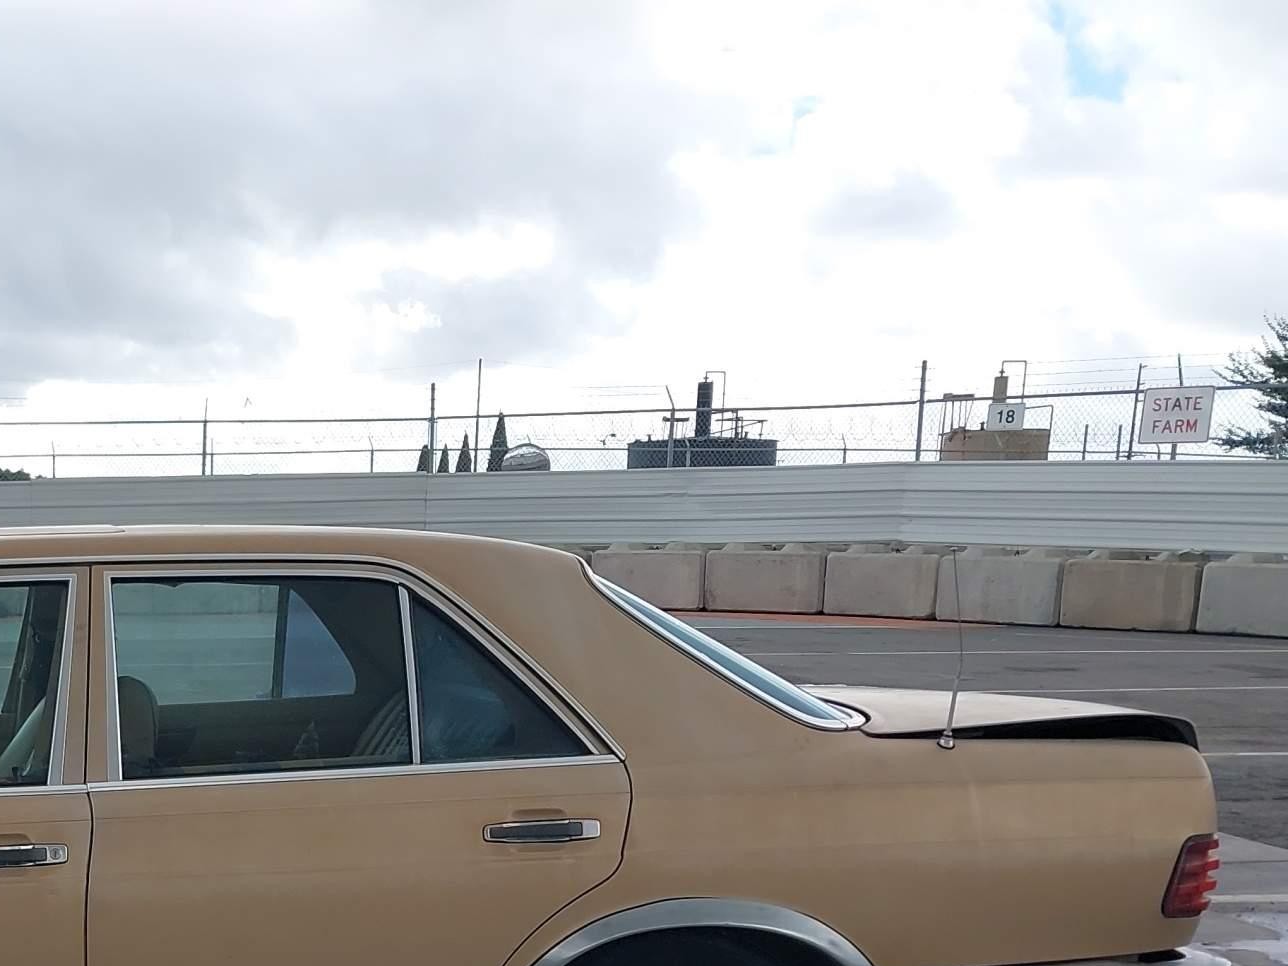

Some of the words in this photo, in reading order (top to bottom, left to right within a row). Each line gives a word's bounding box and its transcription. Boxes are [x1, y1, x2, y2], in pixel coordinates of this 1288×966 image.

[1153, 396, 1203, 412] STATE
[997, 410, 1015, 424] 18
[1152, 418, 1198, 434] FARM
